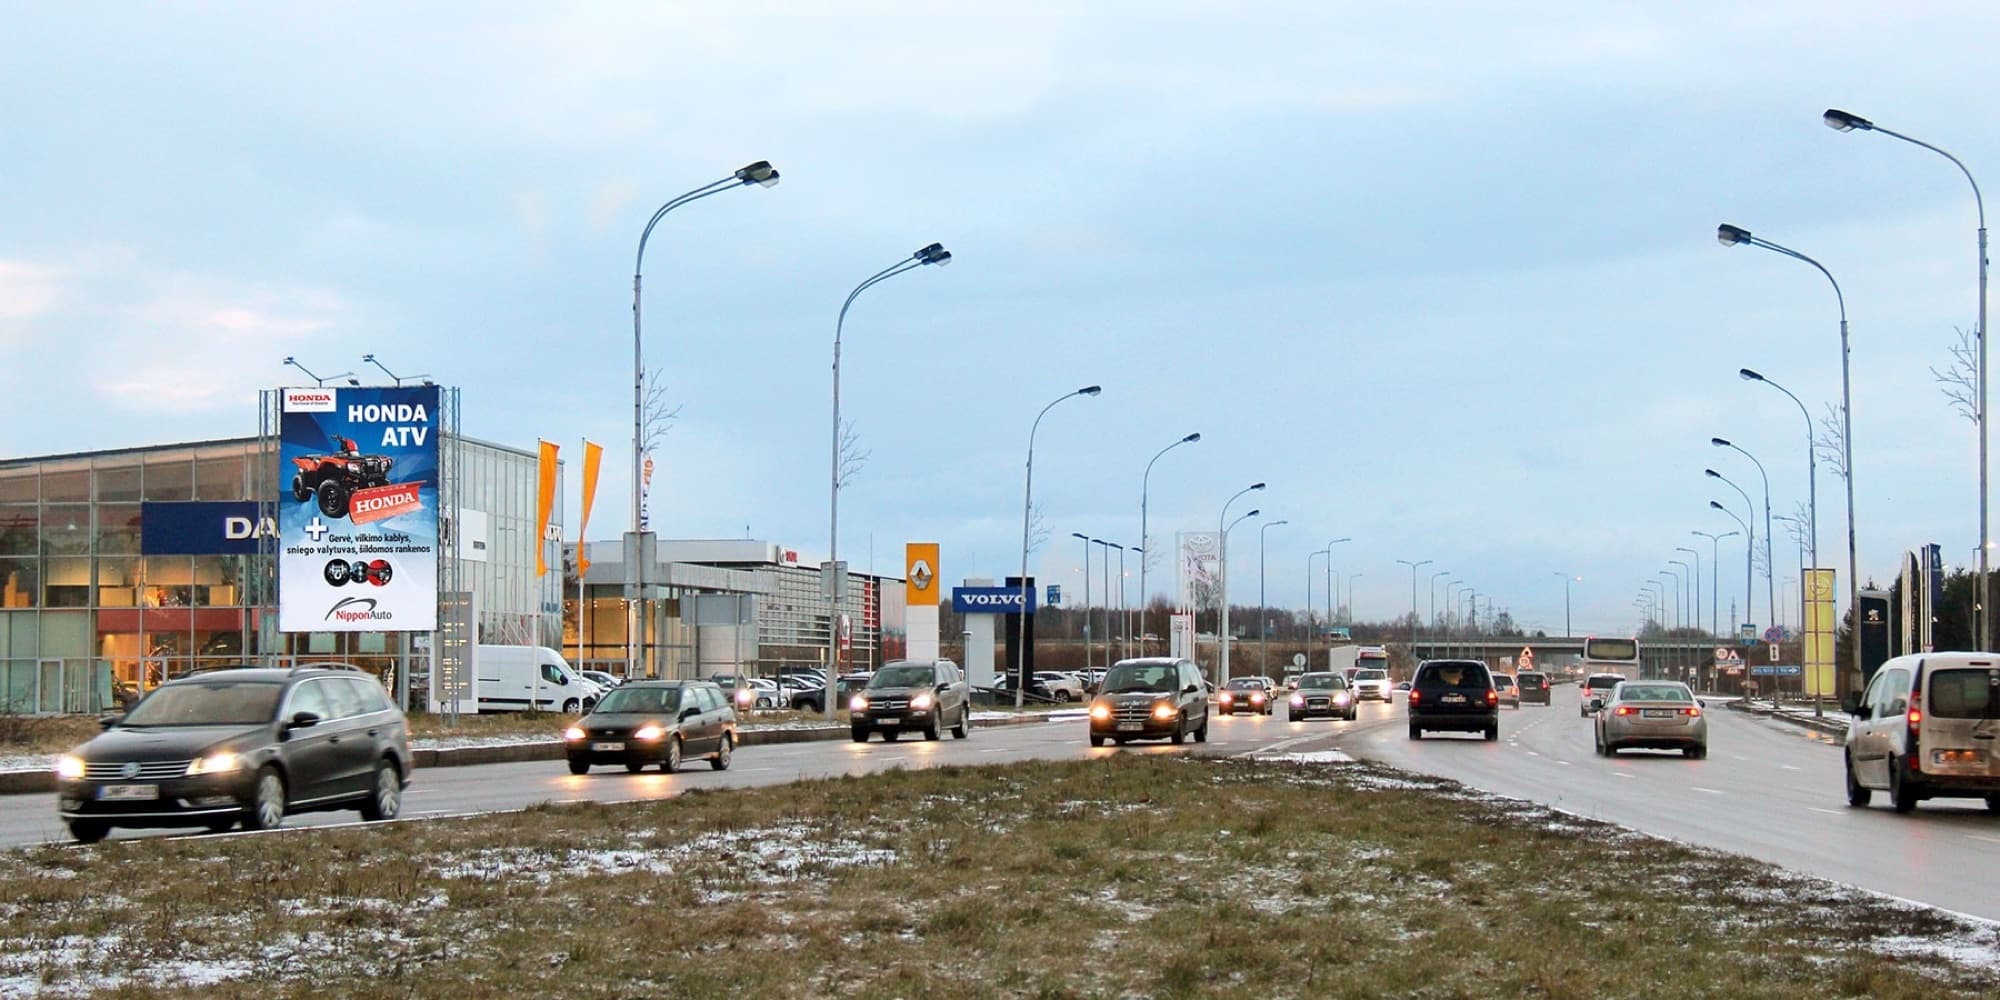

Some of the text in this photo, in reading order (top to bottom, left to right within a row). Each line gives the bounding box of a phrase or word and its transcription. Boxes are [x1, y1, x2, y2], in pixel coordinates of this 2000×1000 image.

[348, 404, 428, 422] HONDA
[381, 426, 428, 447] ATV
[355, 492, 416, 514] HONDA
[355, 533, 382, 542] vilkimo
[384, 533, 412, 543] kablys,
[287, 547, 315, 556] sniego
[316, 546, 358, 556] valytuvas,
[395, 545, 431, 553] rankenos
[961, 594, 1027, 605] VOLVO
[336, 610, 392, 622] NipponAuto
